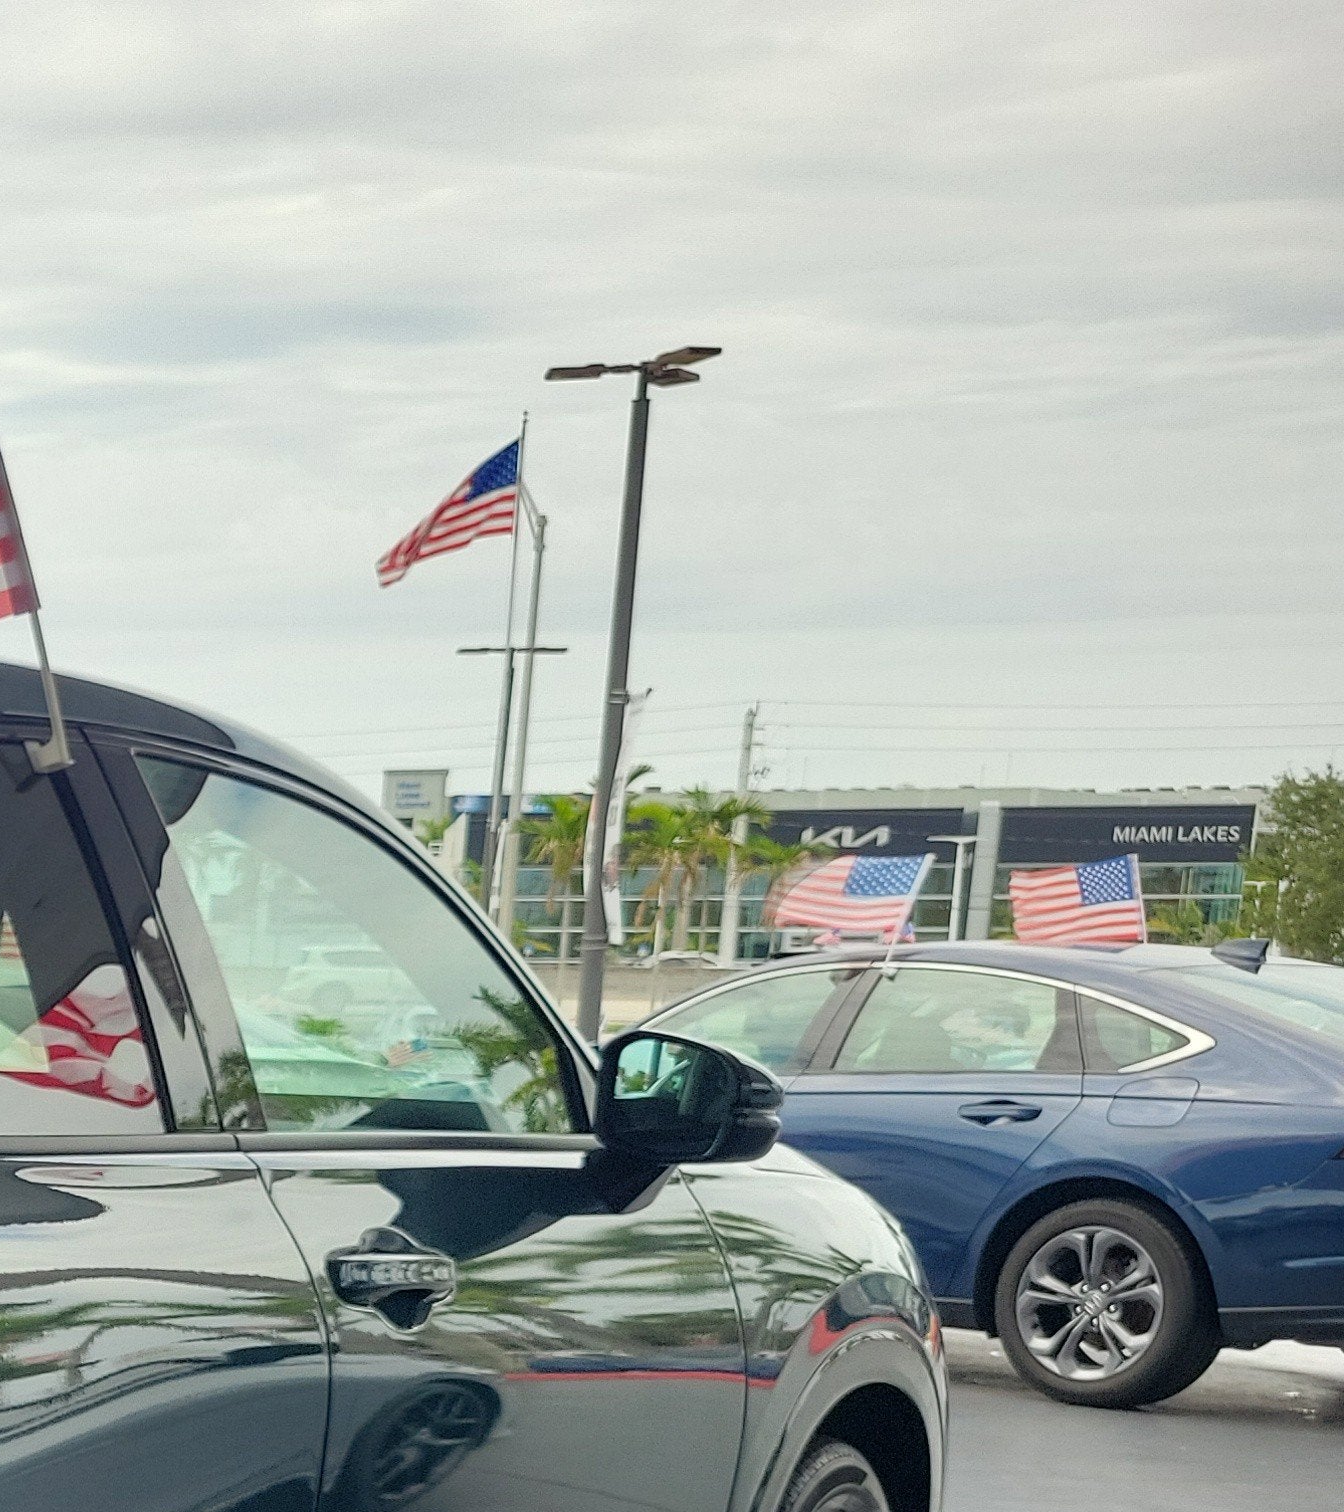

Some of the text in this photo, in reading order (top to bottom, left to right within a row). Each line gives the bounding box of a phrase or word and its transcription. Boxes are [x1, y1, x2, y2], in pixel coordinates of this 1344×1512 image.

[800, 825, 891, 849] KIA
[1113, 825, 1241, 843] MIAMI LAKES
